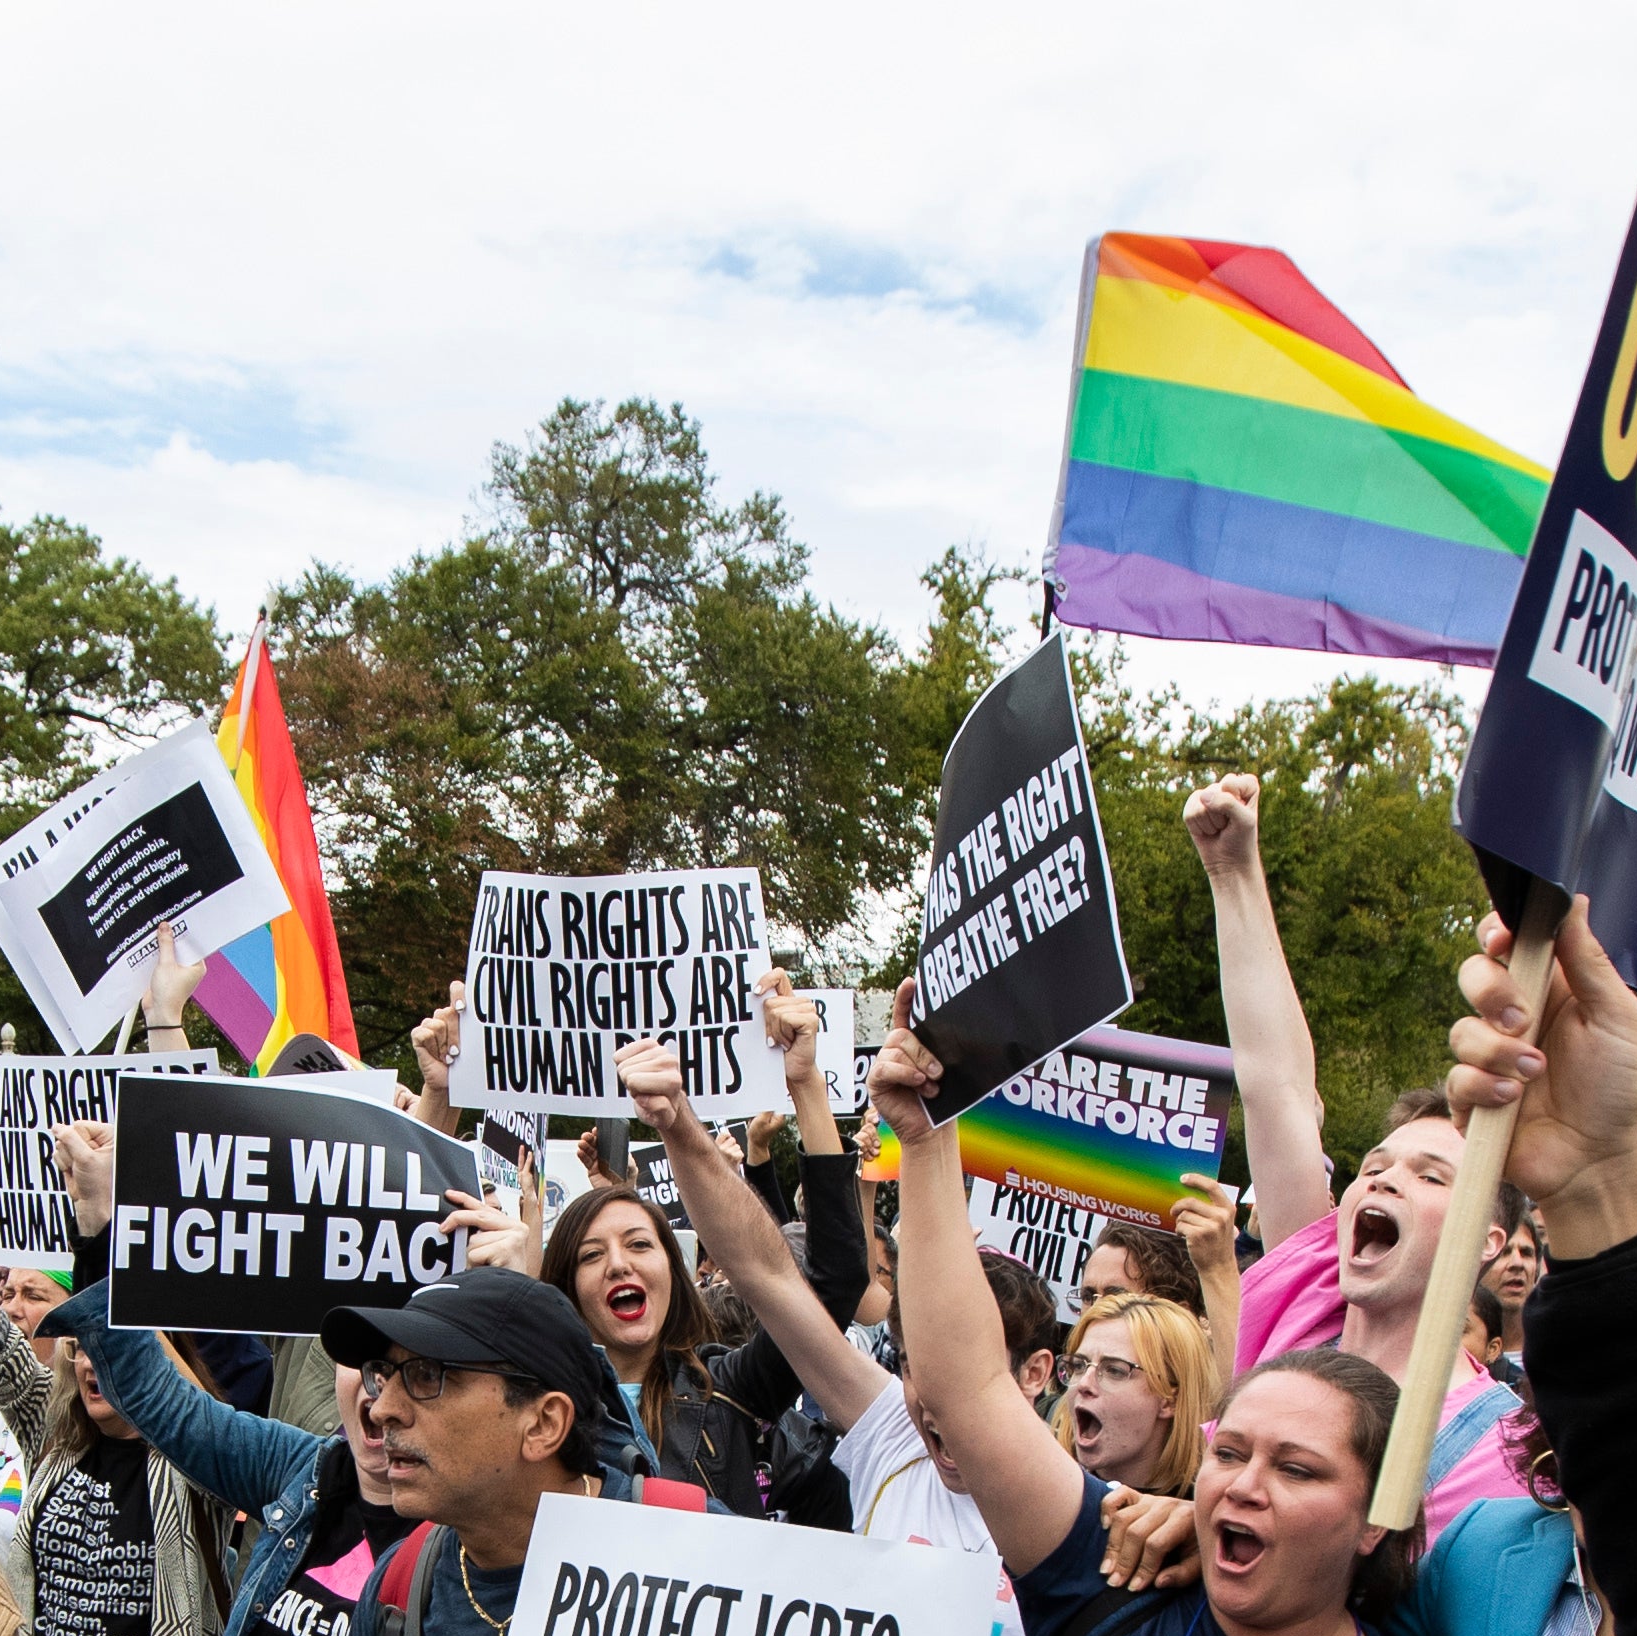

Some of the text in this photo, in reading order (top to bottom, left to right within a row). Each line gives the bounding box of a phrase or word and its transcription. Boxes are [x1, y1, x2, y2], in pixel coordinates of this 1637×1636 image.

[85, 825, 147, 882] WE FIGHT BACK
[85, 837, 169, 908] against transphobia,
[132, 866, 151, 886] and
[149, 848, 183, 873] bigotry
[927, 745, 1084, 934] HAS THE RIGHT
[127, 888, 146, 909] and
[142, 862, 190, 896] worldwide
[475, 882, 759, 960] TRANS RIGHTS ARE
[127, 938, 160, 968] HEALT
[922, 898, 1019, 1013] BREATHE
[1012, 836, 1091, 943] FREE?
[473, 955, 542, 1027] CIVIL
[549, 959, 677, 1030] RIGHTS
[689, 953, 753, 1027] ARE
[484, 1026, 605, 1098] HUMAN
[1039, 1052, 1209, 1115] ARE THE
[990, 1076, 1219, 1153] ORKFORCE
[176, 1130, 271, 1200] WE
[290, 1137, 440, 1212] WILL
[1023, 1175, 1161, 1226] HOUSING WORKS
[115, 1204, 317, 1278] FIGHT
[1010, 1227, 1067, 1283] CIVIL
